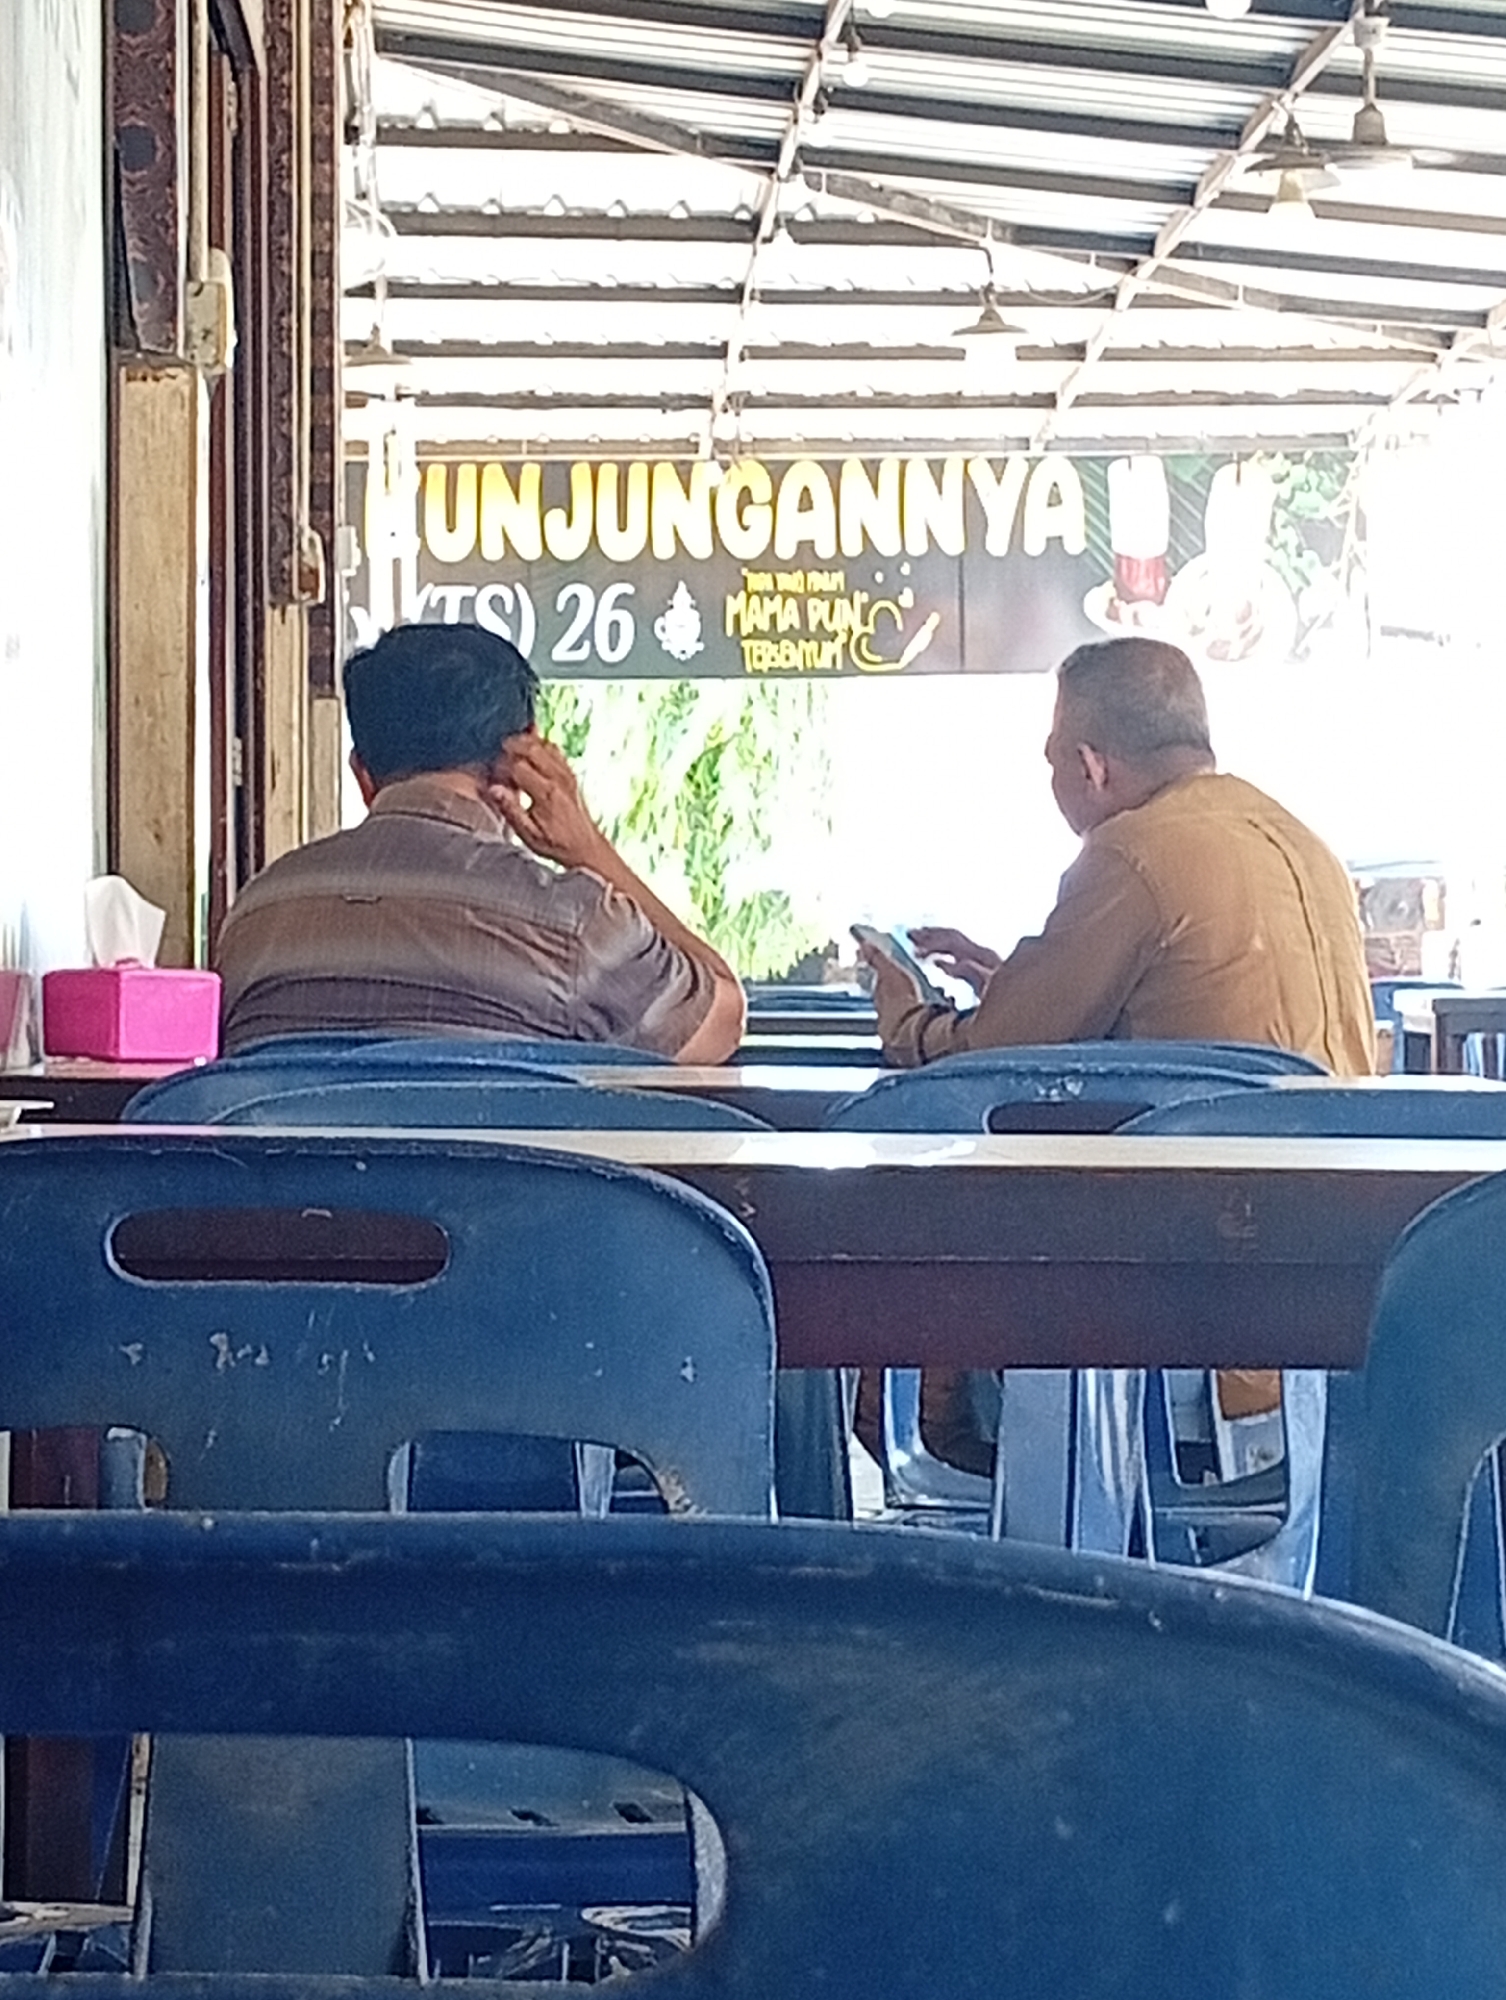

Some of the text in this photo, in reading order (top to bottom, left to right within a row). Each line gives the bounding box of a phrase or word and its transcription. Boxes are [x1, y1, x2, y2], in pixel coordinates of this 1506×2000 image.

[368, 457, 1086, 564] UNJUNGANNYA
[550, 582, 635, 664] 26
[725, 590, 862, 637] MAMA PUN
